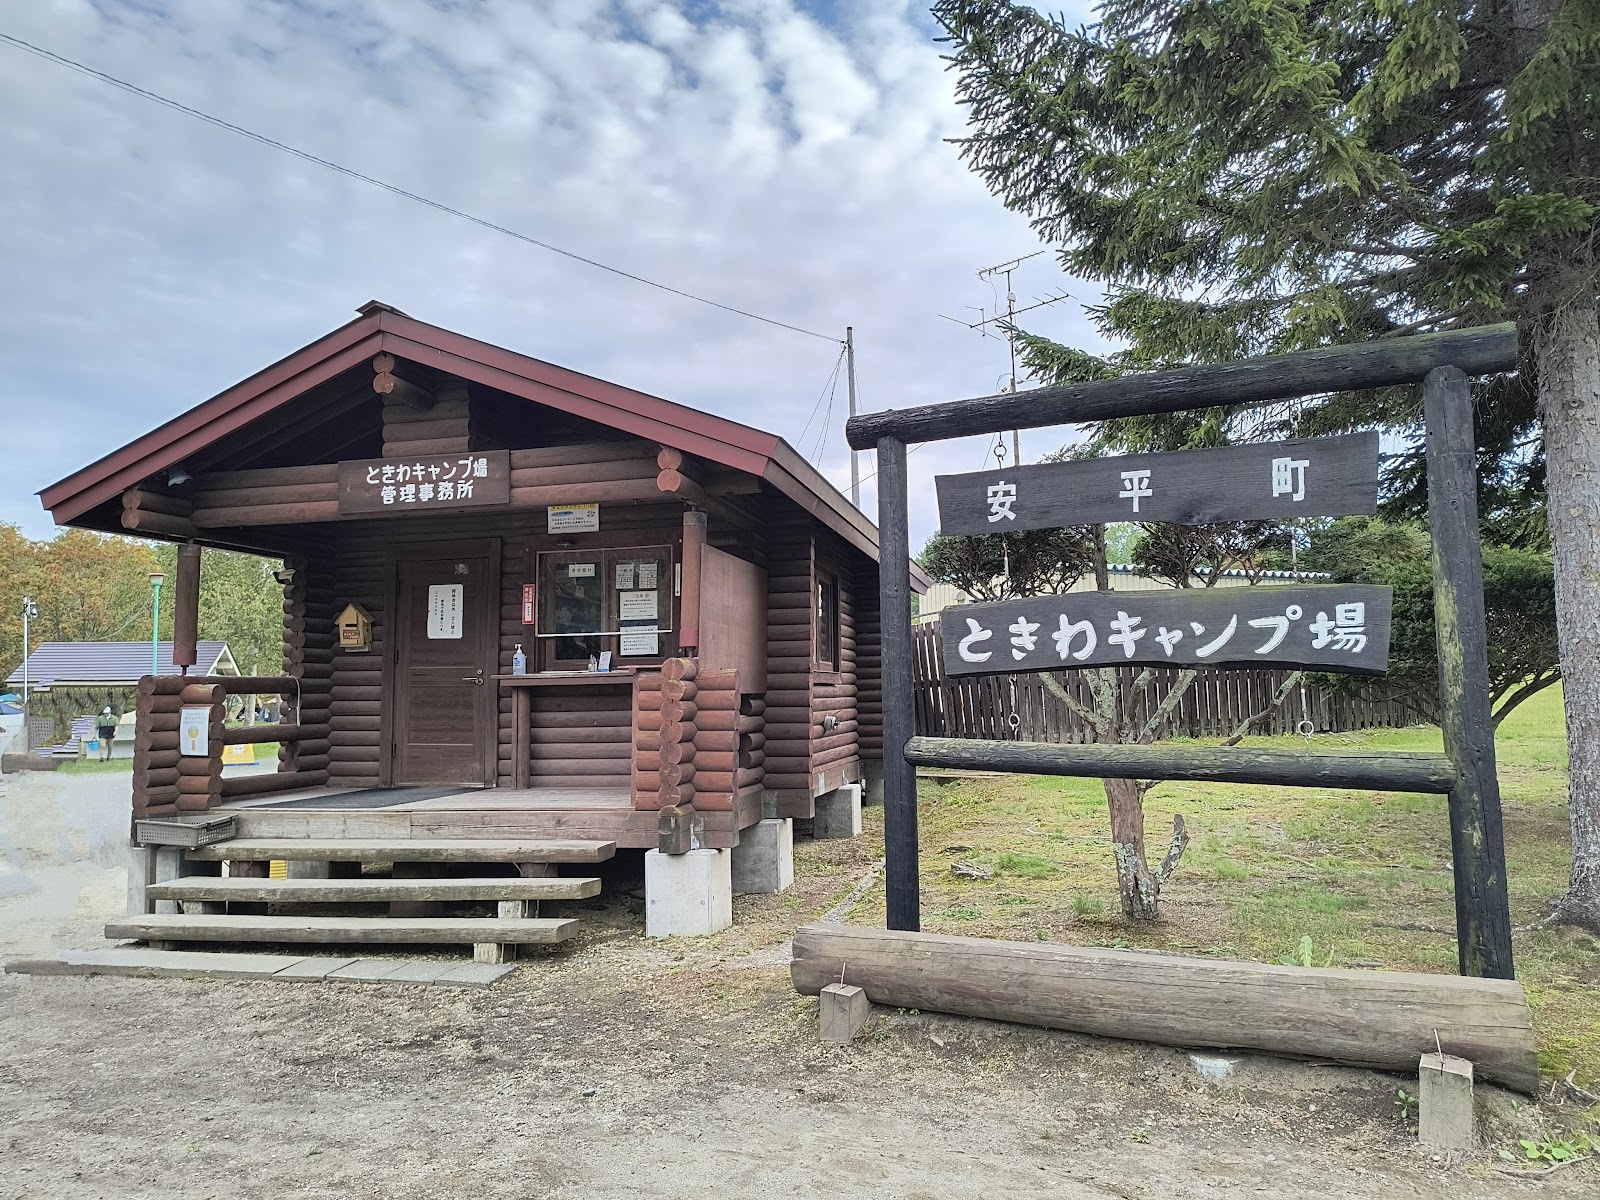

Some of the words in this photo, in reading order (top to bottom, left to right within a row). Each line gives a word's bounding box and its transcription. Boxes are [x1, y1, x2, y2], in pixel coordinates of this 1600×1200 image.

[366, 456, 488, 485] ときわキャンプ場
[381, 479, 474, 505] 管理事務所
[986, 457, 1310, 523] 安平町
[958, 602, 1368, 663] ときわキャンプ場
